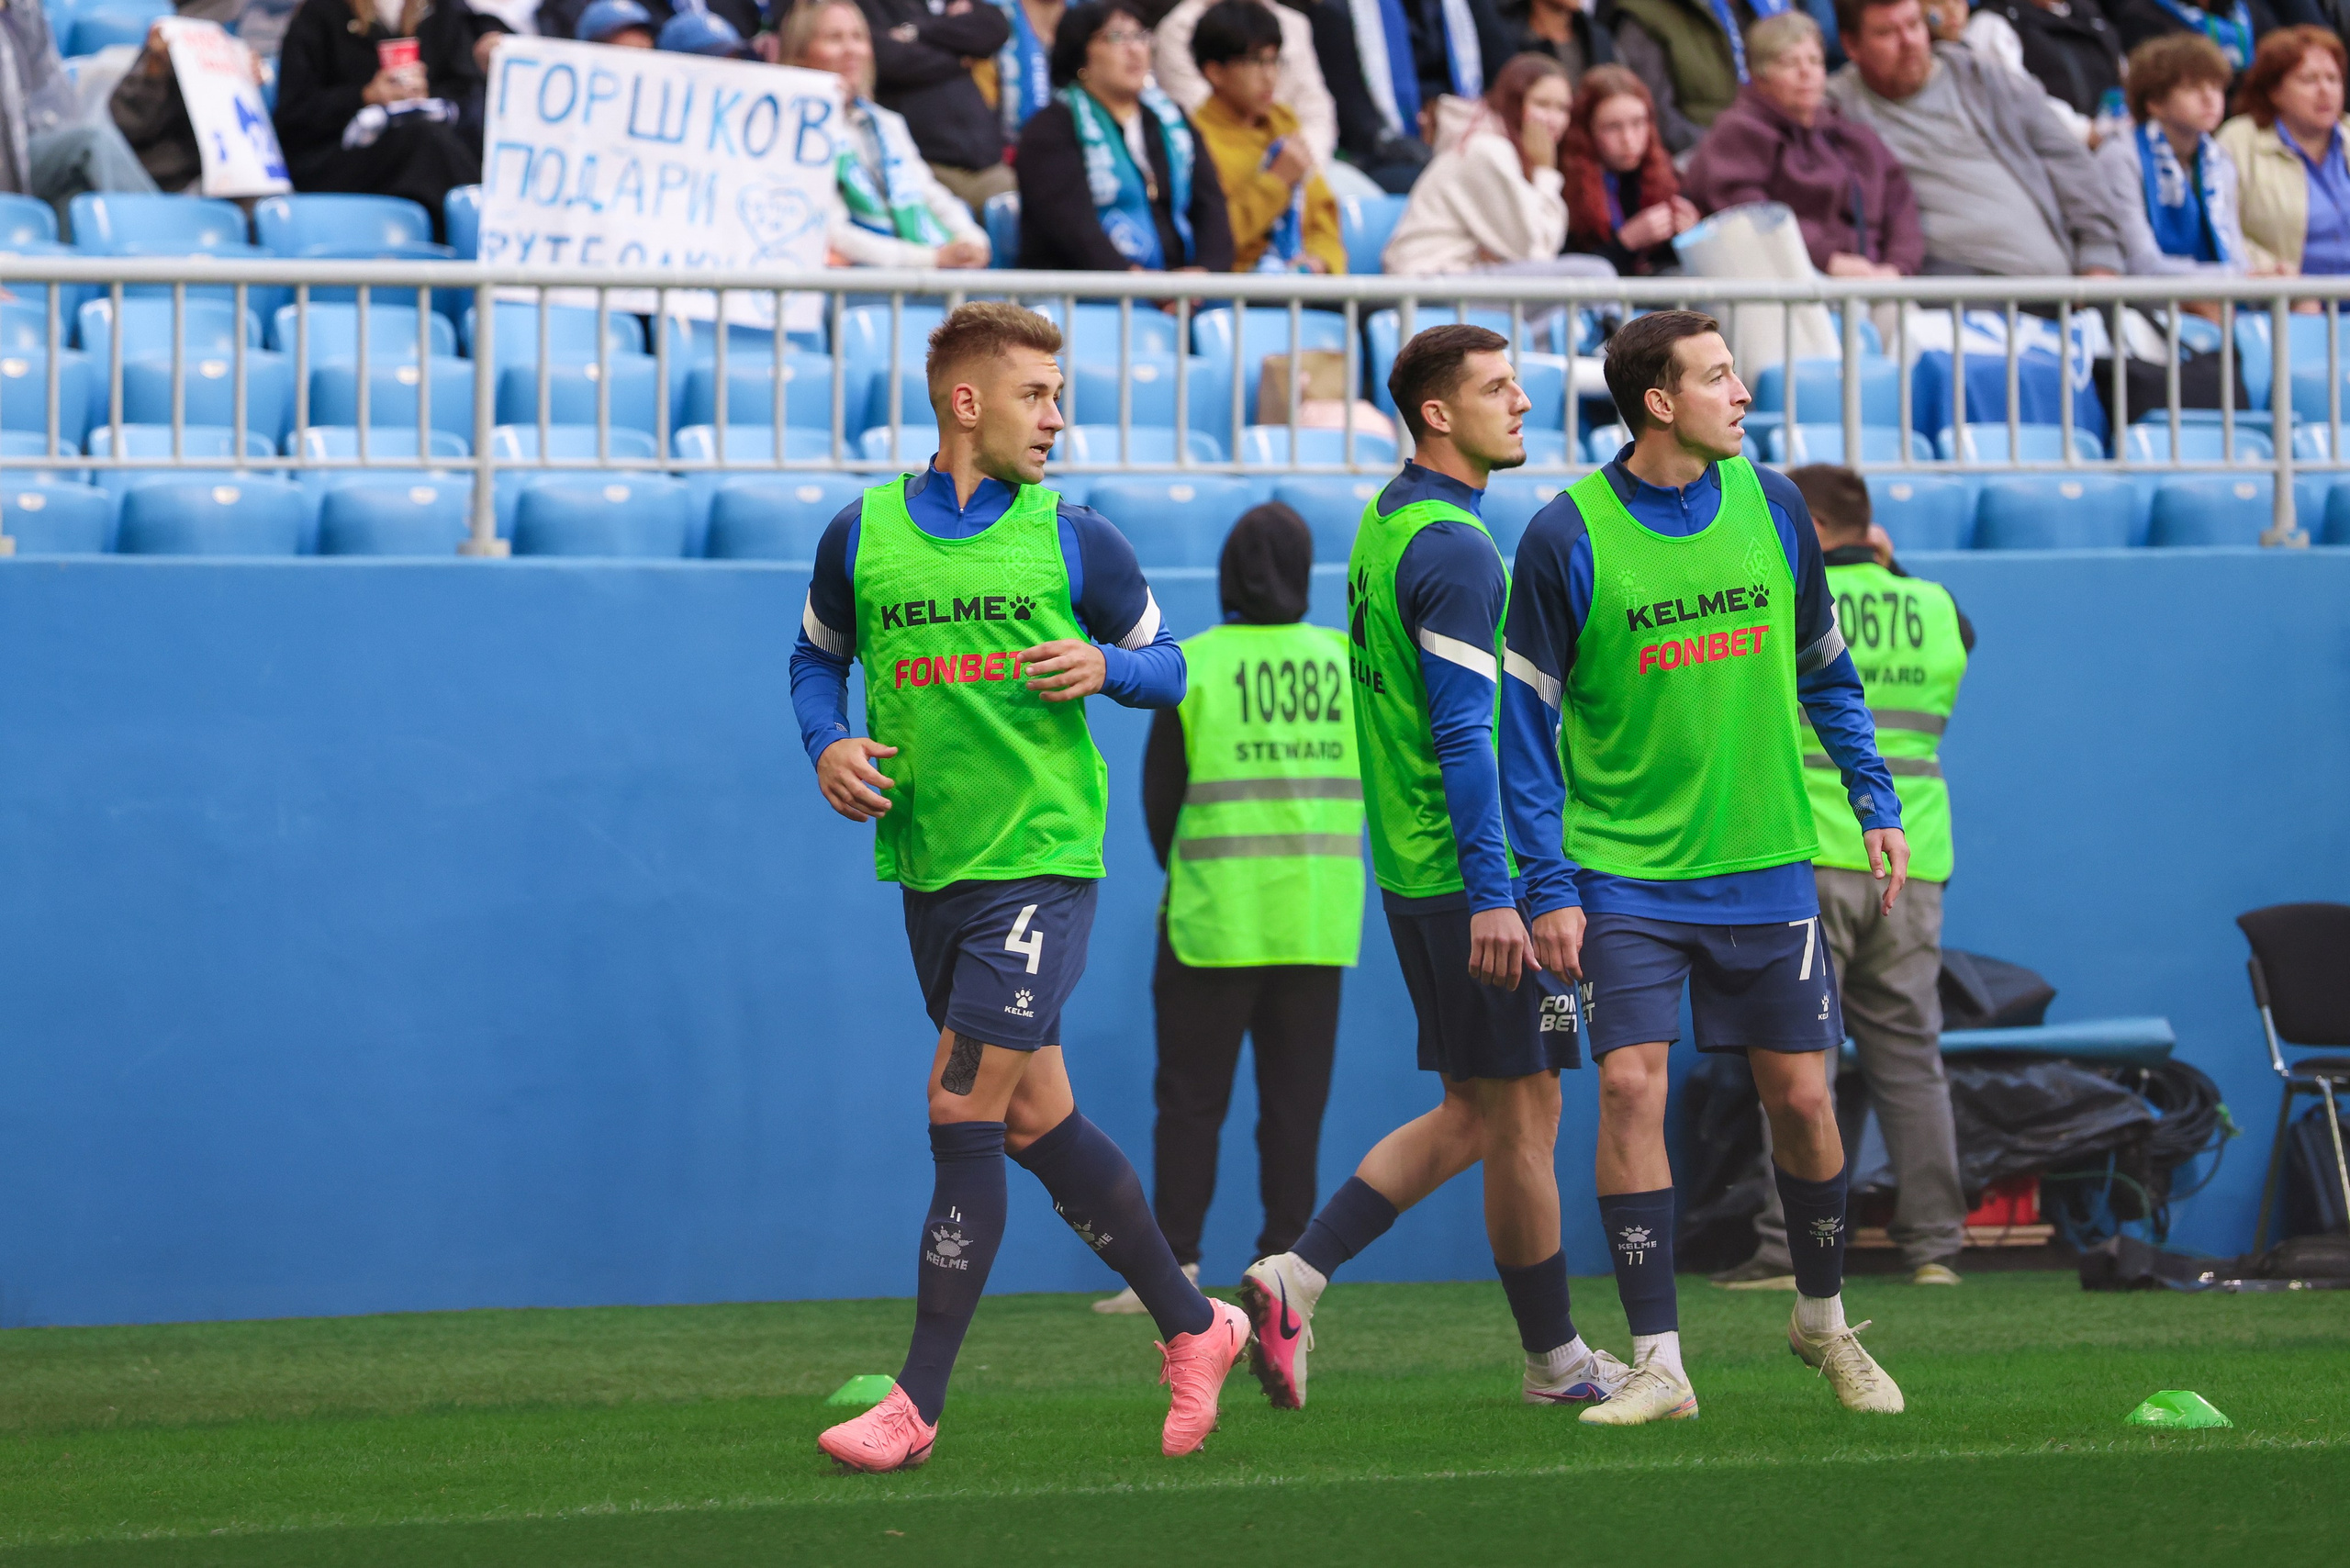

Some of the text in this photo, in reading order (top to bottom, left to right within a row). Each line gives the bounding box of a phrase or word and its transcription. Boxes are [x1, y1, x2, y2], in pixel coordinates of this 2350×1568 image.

[499, 57, 836, 167] ГОРШКОВ
[489, 141, 720, 226] ПОДАРИ
[880, 596, 1007, 630] KELME
[1626, 588, 1749, 633] KELME
[1839, 593, 1923, 649] 0676
[1639, 625, 1770, 675] FONBET
[895, 651, 1024, 689] FONBET
[1863, 667, 1926, 685] WARD
[1235, 660, 1341, 722] 10382
[1236, 741, 1345, 761] STEWARD
[1004, 903, 1044, 975] 4
[1004, 1005, 1035, 1018] KELME
[1539, 1014, 1578, 1033] BET
[1617, 1240, 1657, 1250] KELME
[1626, 1251, 1644, 1265] 77
[1817, 1237, 1834, 1248] 77
[926, 1250, 969, 1271] KELME
